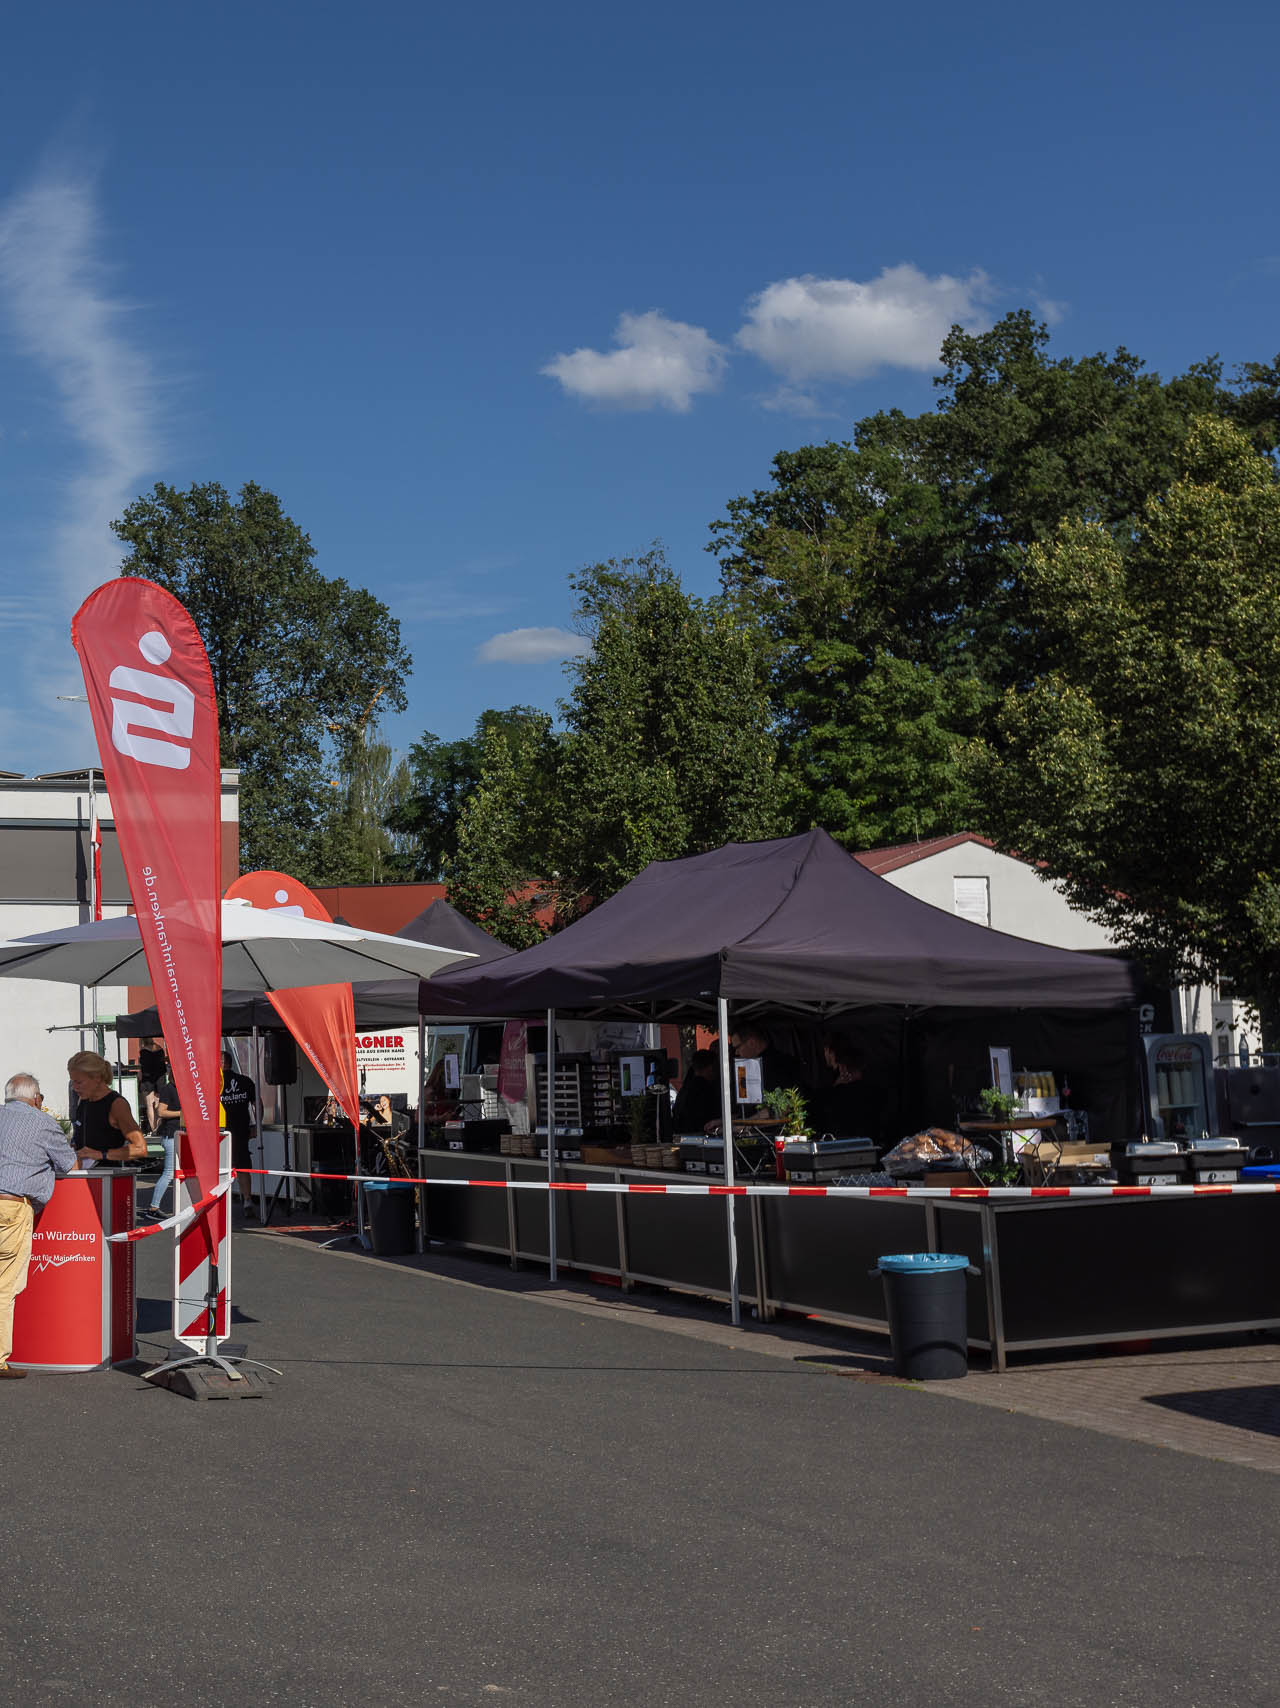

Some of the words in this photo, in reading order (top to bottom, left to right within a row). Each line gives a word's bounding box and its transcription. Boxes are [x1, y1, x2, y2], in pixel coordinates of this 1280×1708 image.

[355, 1036, 404, 1048] AGNER
[46, 1231, 96, 1244] Würzburg
[53, 1254, 96, 1262] Mainfranken
